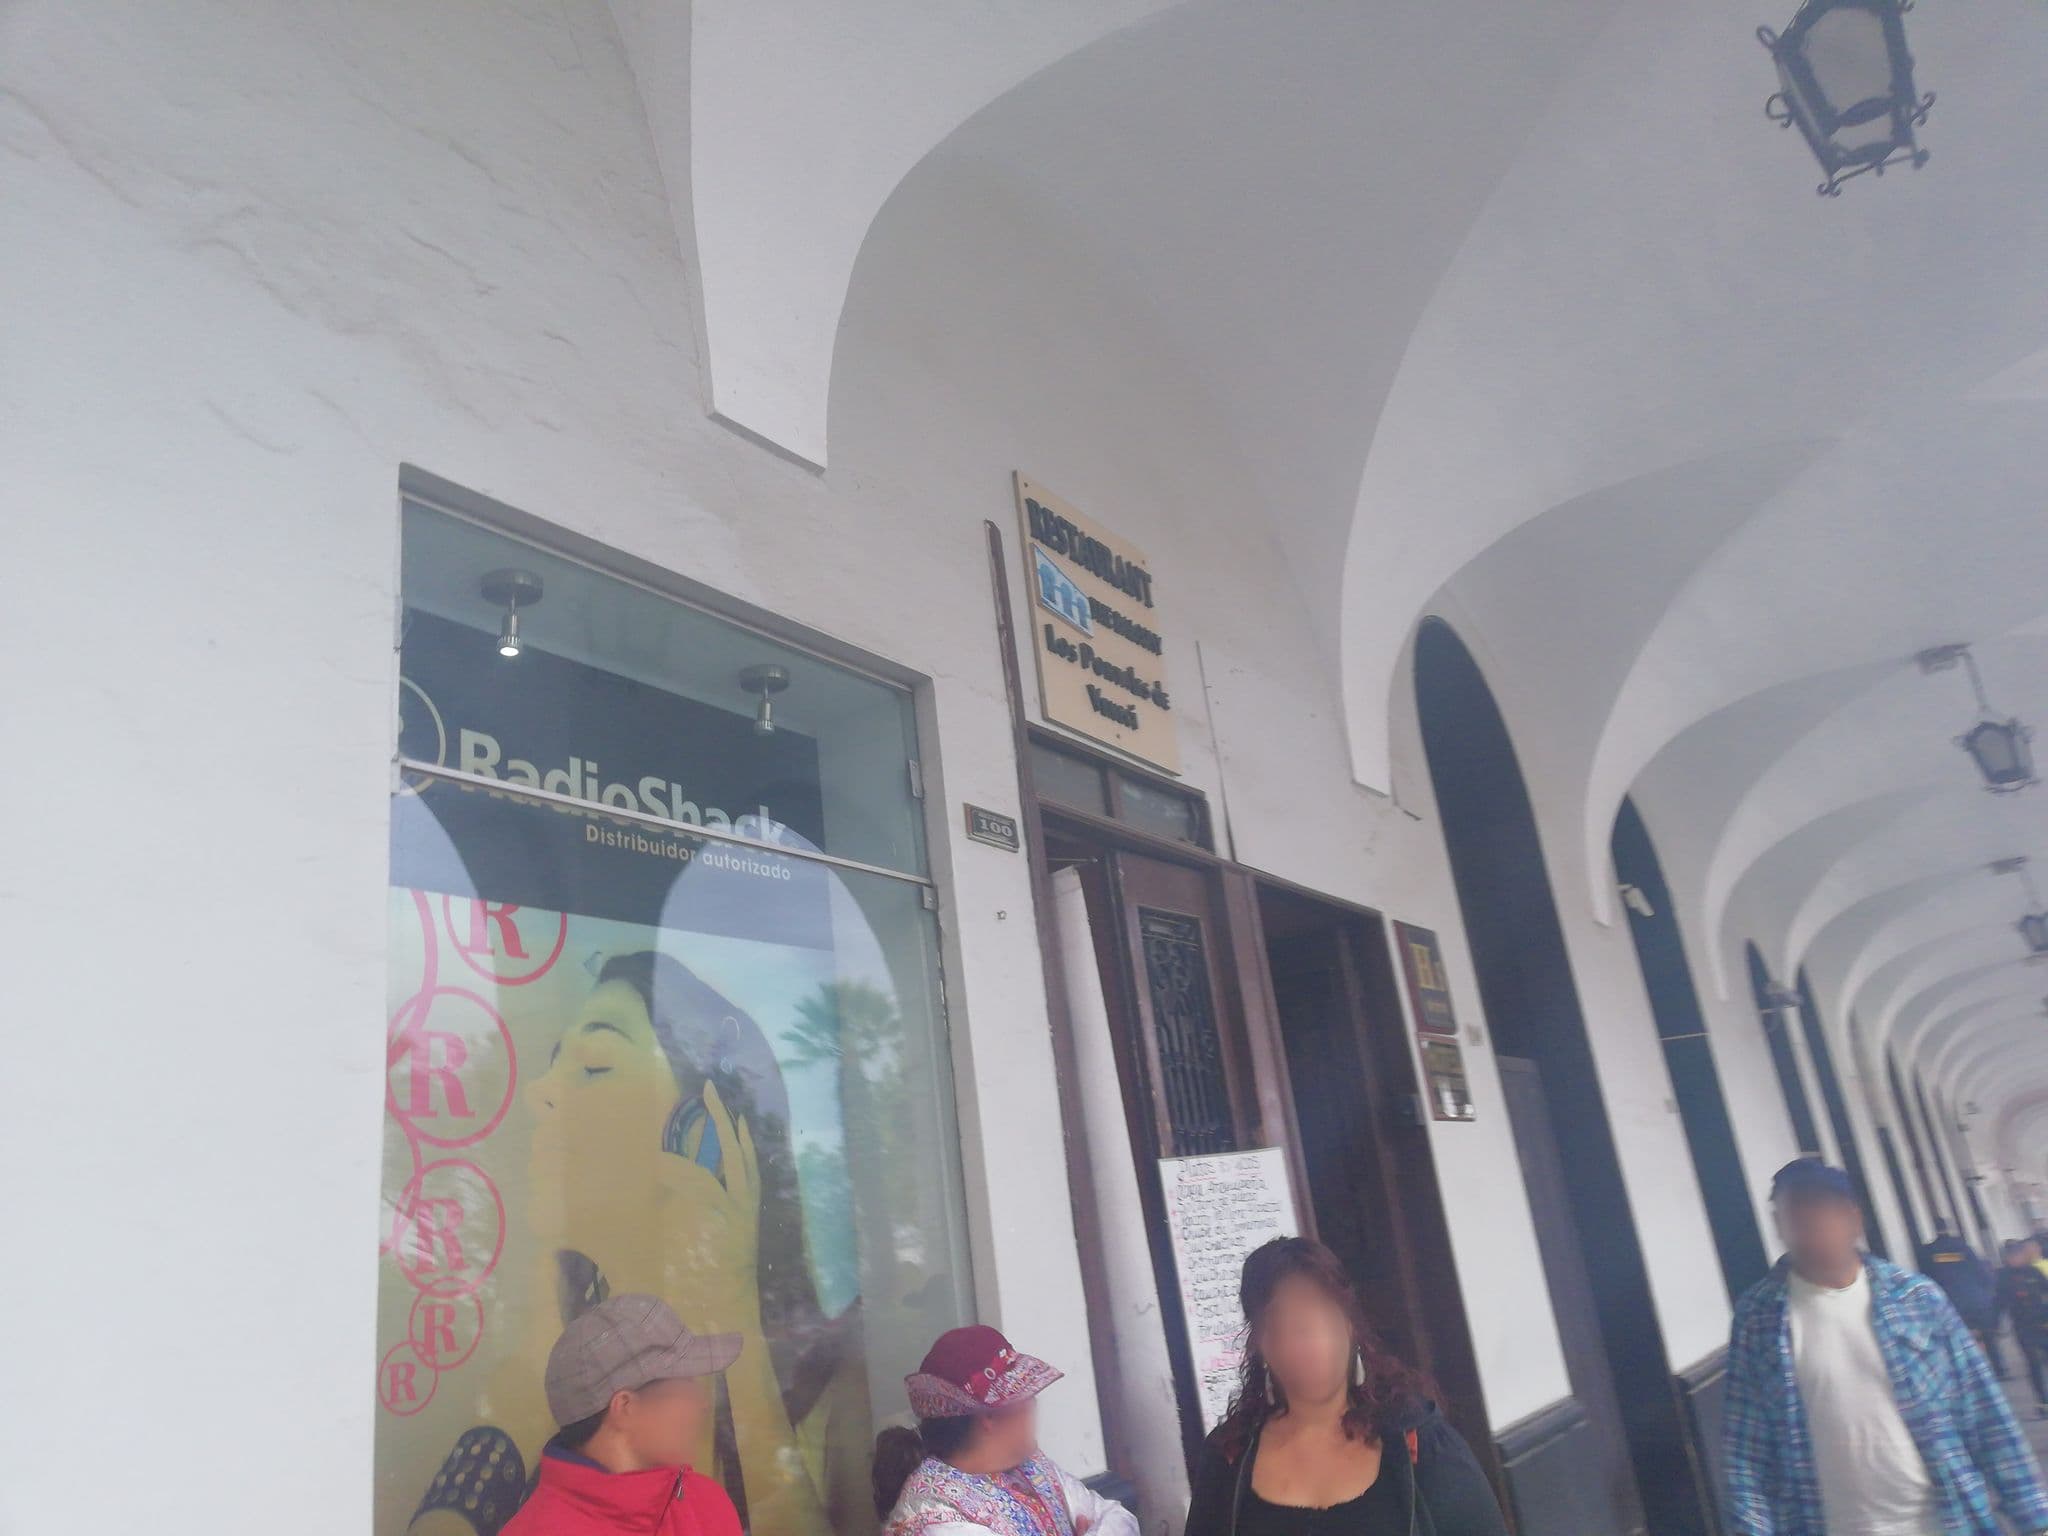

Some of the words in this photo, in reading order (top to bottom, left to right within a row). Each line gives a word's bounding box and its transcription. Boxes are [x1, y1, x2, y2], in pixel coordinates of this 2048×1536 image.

[459, 728, 792, 860] RadioShack
[585, 823, 696, 863] Distribuidor
[702, 852, 792, 881] autorizado
